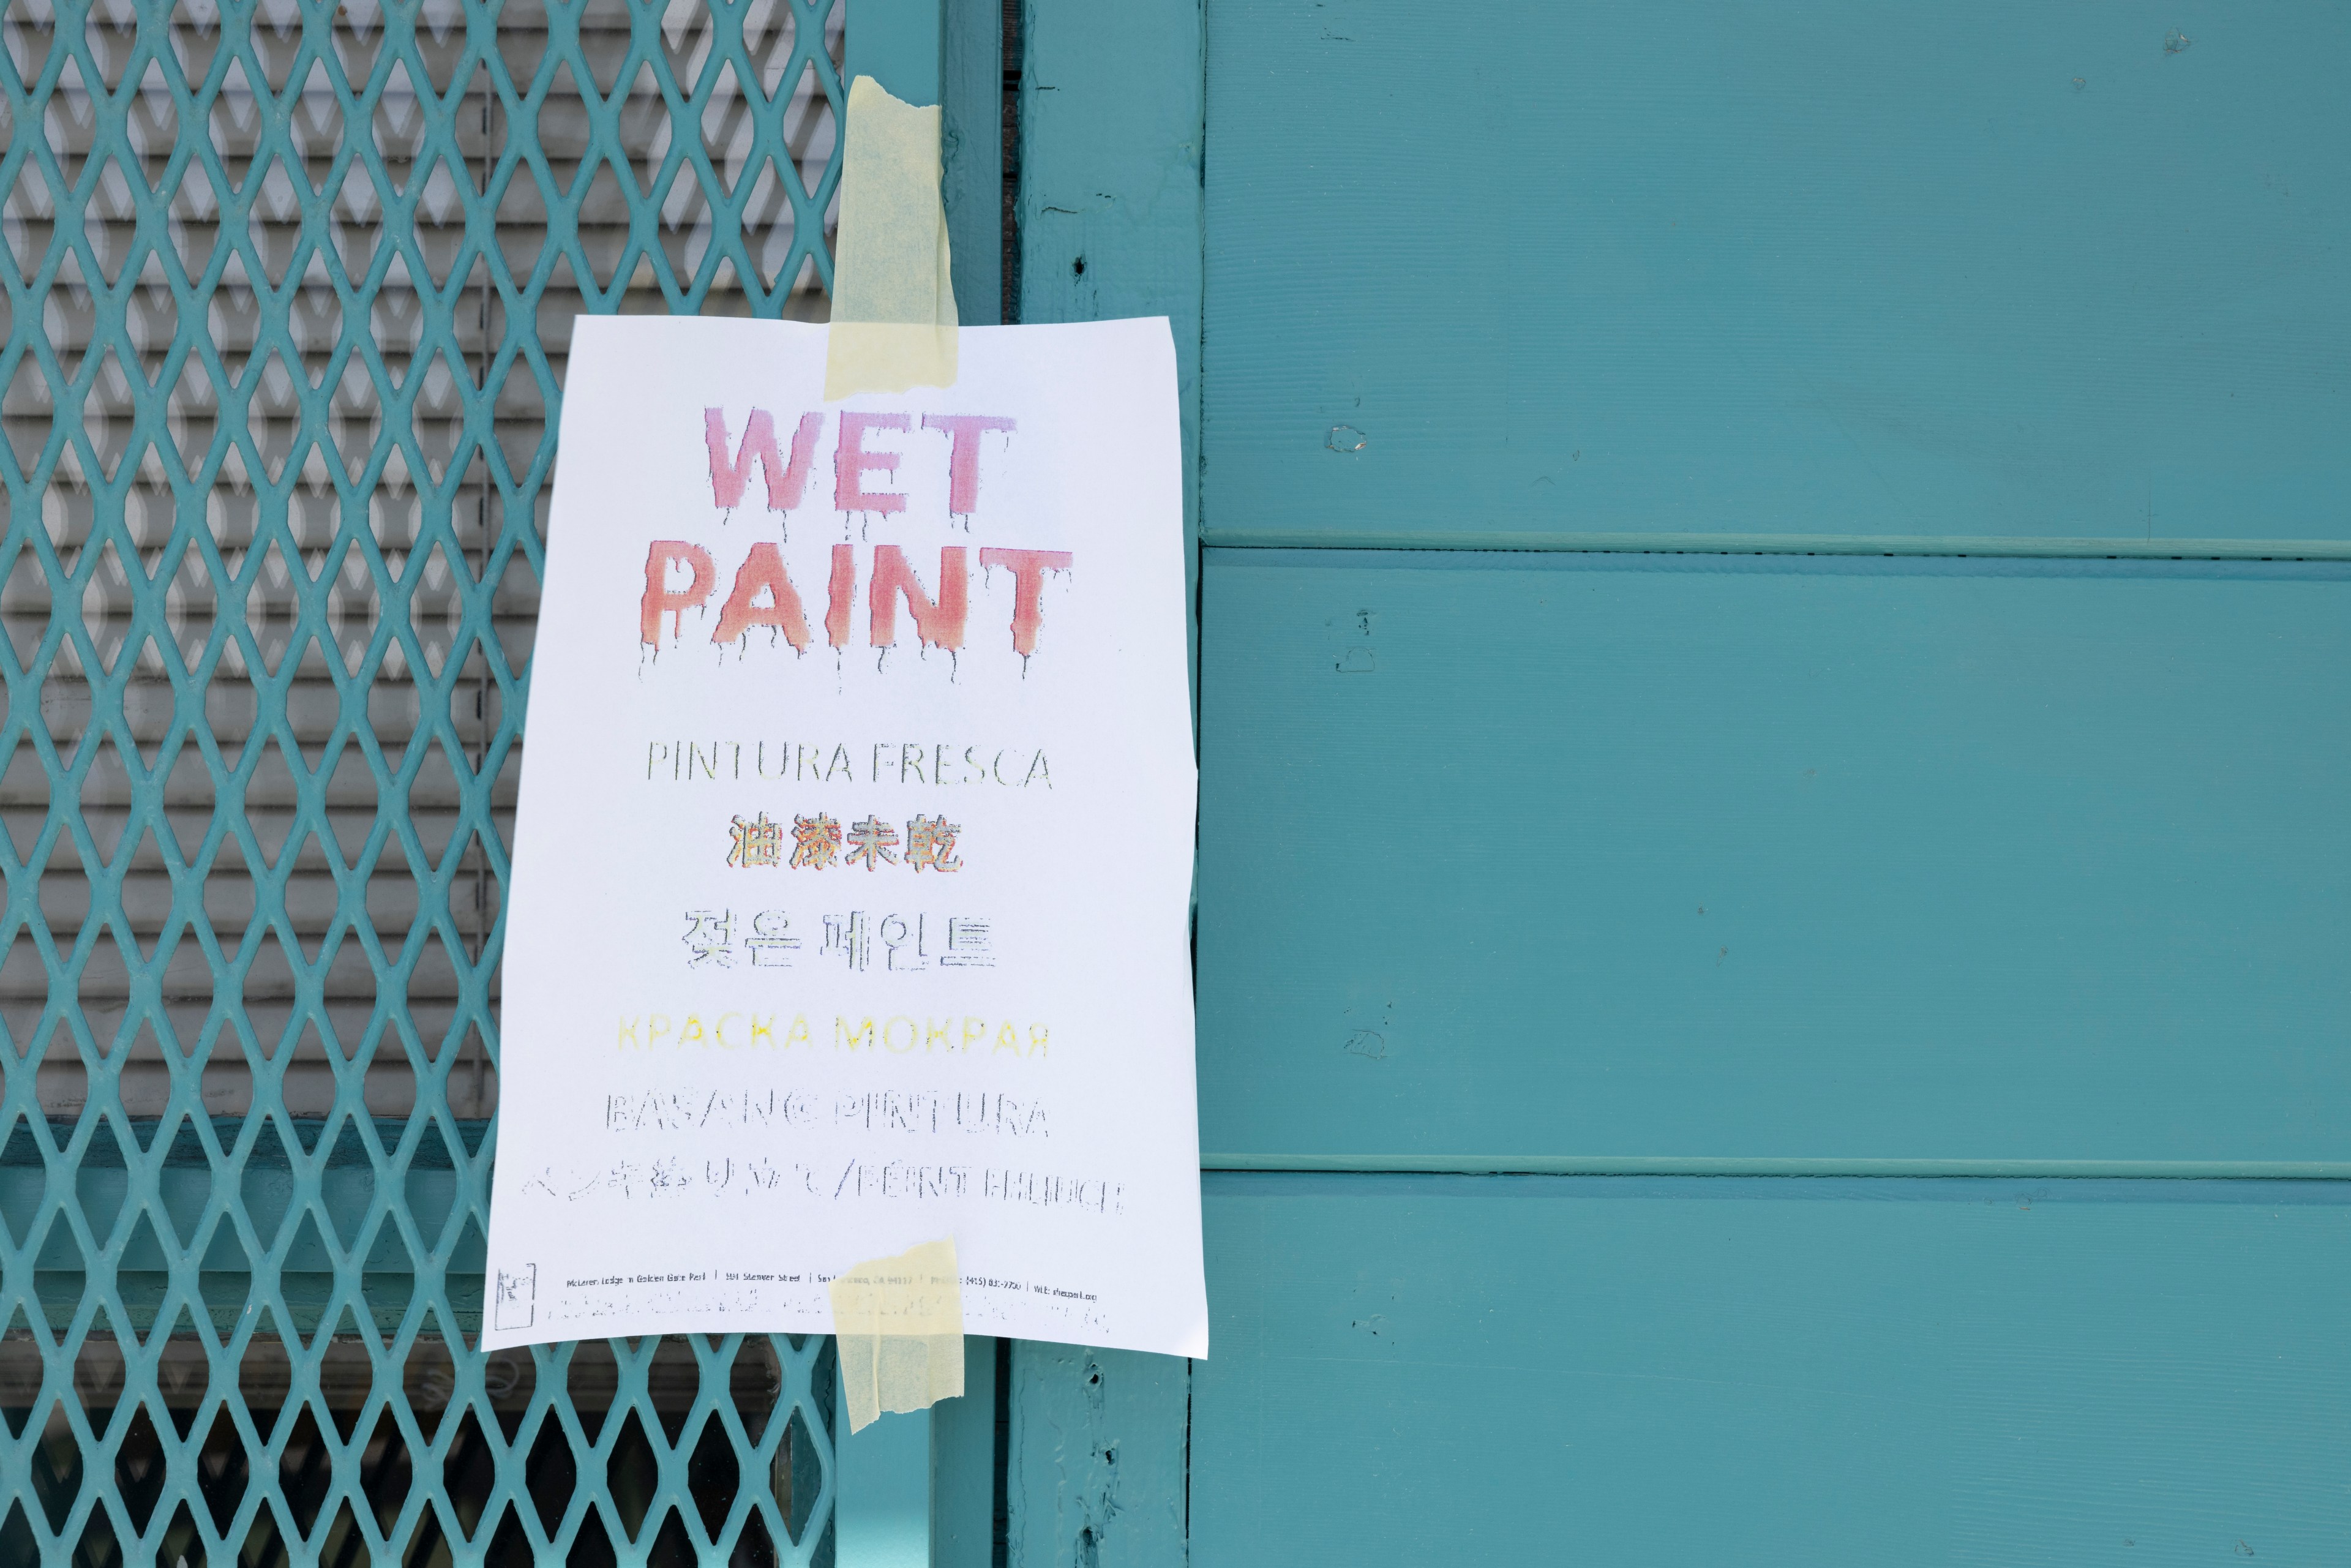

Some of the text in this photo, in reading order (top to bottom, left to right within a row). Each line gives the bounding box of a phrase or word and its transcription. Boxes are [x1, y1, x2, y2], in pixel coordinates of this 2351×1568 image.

[703, 407, 1018, 541] WET
[639, 540, 1073, 695] PAINT
[648, 740, 1052, 789] PINTURA FRESCA
[726, 811, 963, 874] 油漆未乾
[820, 910, 996, 972] 페인트
[618, 1011, 1049, 1059] КРАСКА МОКРАЯ
[835, 1092, 1048, 1137] PINTURA
